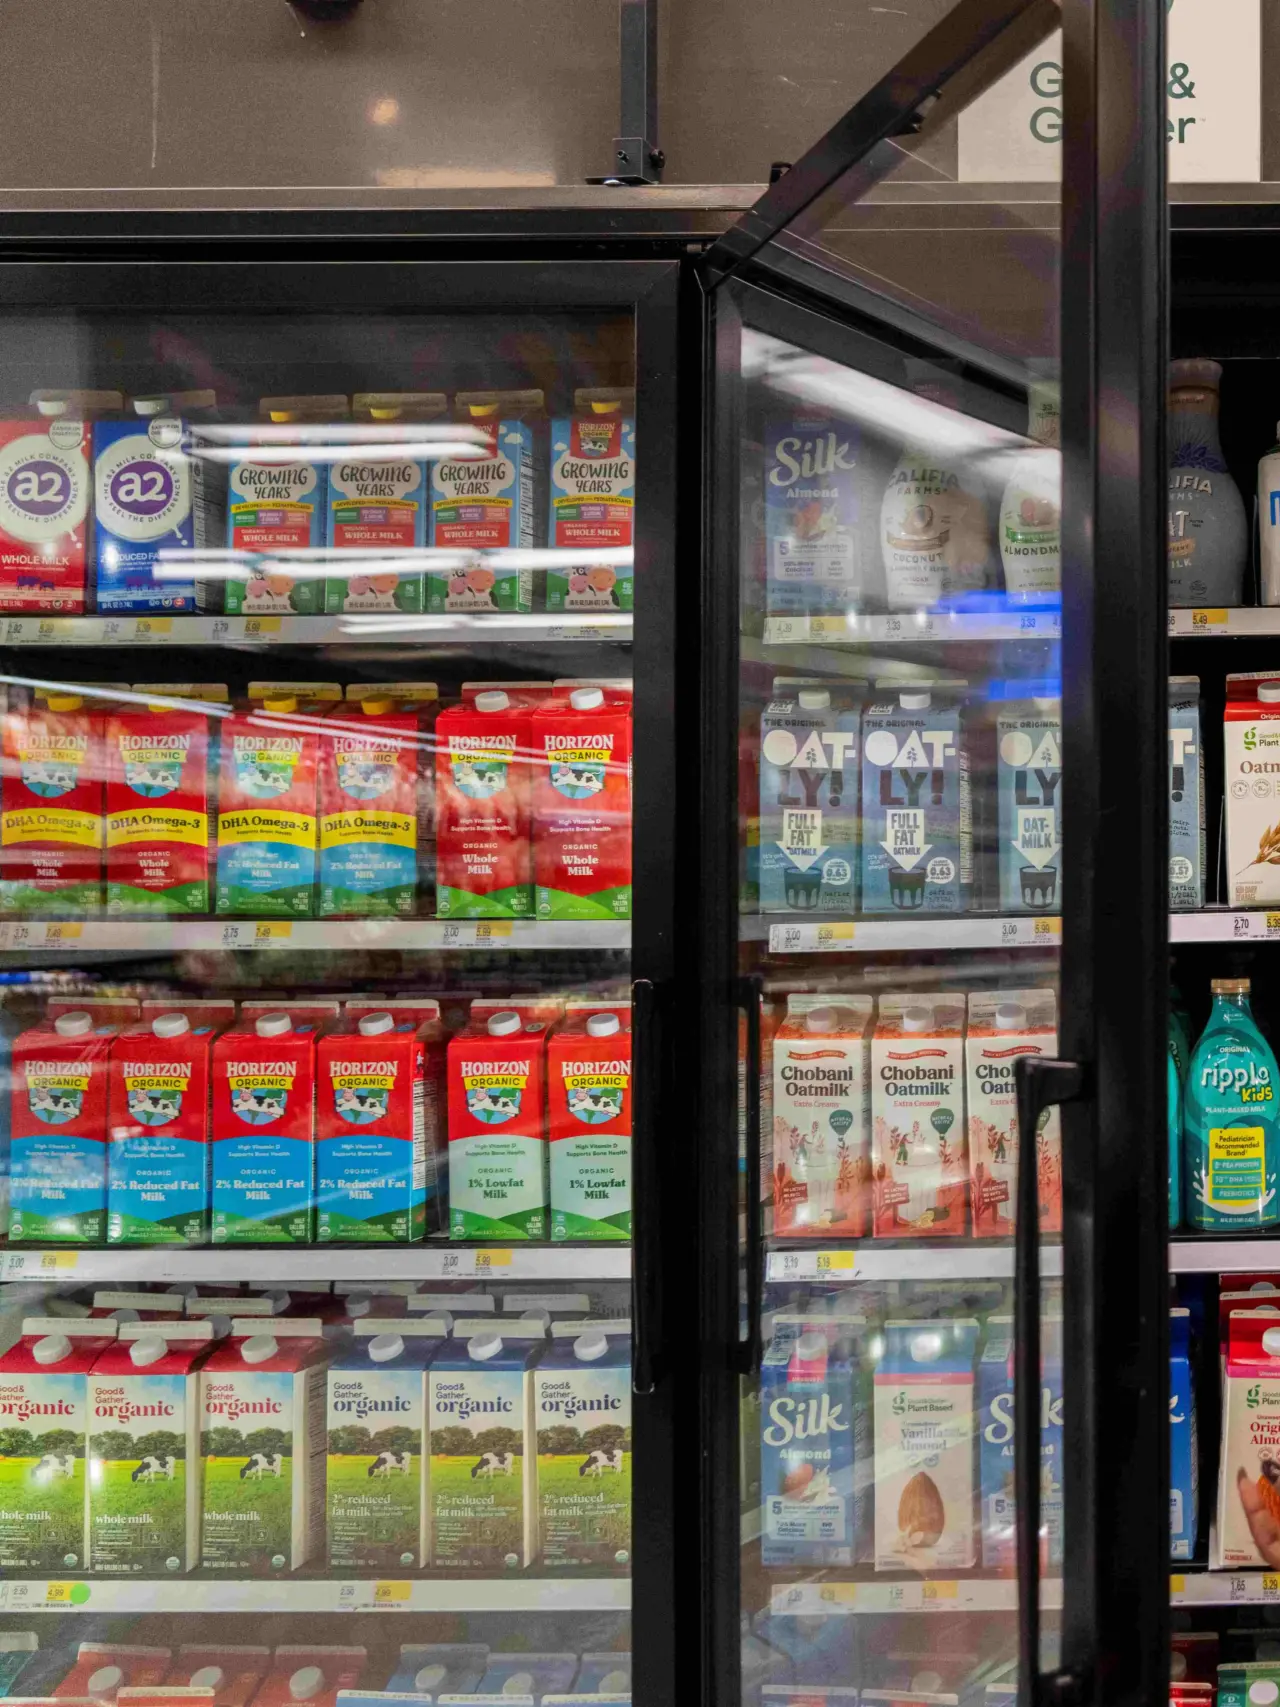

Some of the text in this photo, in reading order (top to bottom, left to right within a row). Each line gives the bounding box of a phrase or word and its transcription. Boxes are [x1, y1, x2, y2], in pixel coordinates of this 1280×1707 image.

[579, 423, 615, 432] HORIZON
[769, 433, 855, 486] Silk
[239, 468, 308, 485] GROWING
[440, 463, 505, 481] GROWING
[561, 462, 628, 479] GROWING
[15, 472, 63, 502] a2
[118, 472, 166, 502] a2
[254, 487, 290, 499] YEARS
[454, 482, 489, 495] YEARS
[576, 481, 612, 493] YEARS
[786, 488, 838, 498] Almond
[110, 502, 126, 517] FEEL
[148, 479, 180, 522] DIFFERENCE
[1, 555, 69, 565] WHOLE MILK
[764, 719, 826, 728] THE ORIGINAL
[119, 735, 190, 749] HORIZON
[234, 736, 302, 752] HORIZON
[545, 735, 613, 749] HORIZON
[1259, 738, 1278, 746] Plant
[129, 752, 180, 761] ORGANIC
[243, 753, 292, 762] ORGANIC
[554, 752, 603, 761] ORGANIC
[777, 770, 844, 807] LY!
[880, 770, 944, 806] LY!
[111, 815, 200, 829] DHA Omega-3
[222, 816, 309, 831] DHA Omega-3
[788, 813, 817, 830] FULL
[891, 813, 919, 829] FULL
[1024, 818, 1049, 833] OAT-
[791, 830, 812, 845] FAT
[894, 830, 915, 845] FAT
[1022, 833, 1051, 849] MILK
[894, 847, 920, 855] OATMILK
[243, 861, 281, 869] Reduced
[562, 856, 598, 864] Whole
[144, 869, 165, 877] Milk
[252, 869, 271, 877] Milk
[568, 867, 593, 875] Milk
[1234, 919, 1249, 928] 2.70
[1267, 918, 1280, 928] 5.39
[25, 1061, 92, 1076] HORIZON
[124, 1063, 191, 1077] HORIZON
[227, 1062, 296, 1076] HORIZON
[330, 1061, 397, 1076] HORIZON
[461, 1061, 530, 1075] HORIZON
[562, 1060, 631, 1075] HORIZON
[781, 1066, 853, 1081] Chobani
[881, 1065, 954, 1080] Chobani
[34, 1078, 82, 1087] ORGANIC
[132, 1079, 181, 1088] ORGANIC
[236, 1078, 286, 1087] ORGANIC
[339, 1078, 388, 1087] ORGANIC
[471, 1077, 520, 1086] ORGANIC
[572, 1077, 622, 1086] ORGANIC
[1202, 1063, 1269, 1093] ripple
[786, 1081, 850, 1096] Oatmilk
[885, 1081, 950, 1096] Oatmilk
[915, 1100, 940, 1108] Creamy
[1219, 1135, 1255, 1143] Pediatrician
[216, 1180, 305, 1188] 2% Reduced Fat
[569, 1179, 626, 1188] 1% Lowfat
[246, 1191, 270, 1200] Milk
[584, 1190, 609, 1199] Milk
[95, 1401, 174, 1424] organic
[206, 1398, 282, 1420] organic
[334, 1396, 411, 1418] organic
[541, 1394, 621, 1418] organic
[908, 1404, 953, 1412] Plant Based
[763, 1394, 848, 1446] Silk
[779, 1449, 831, 1459] Almond
[348, 1494, 390, 1504] reduced
[332, 1507, 370, 1517] fat milk
[96, 1514, 153, 1524] whole milk
[1263, 1579, 1277, 1590] 3.29
